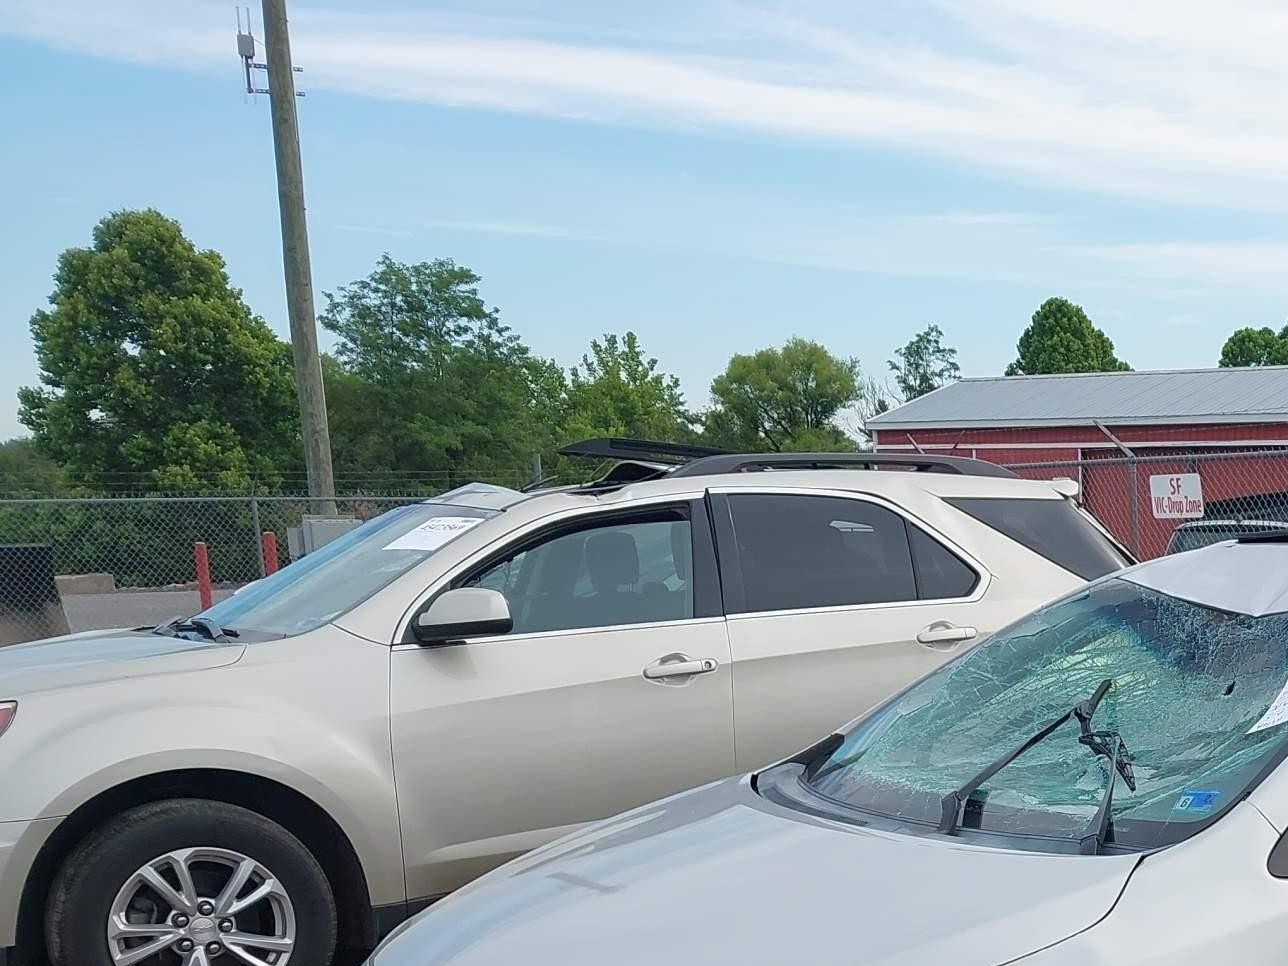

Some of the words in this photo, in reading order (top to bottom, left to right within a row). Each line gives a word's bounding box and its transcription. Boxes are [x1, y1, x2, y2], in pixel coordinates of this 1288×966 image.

[1169, 478, 1182, 495] SF
[1184, 496, 1202, 514] Zone
[1179, 797, 1191, 808] 6
